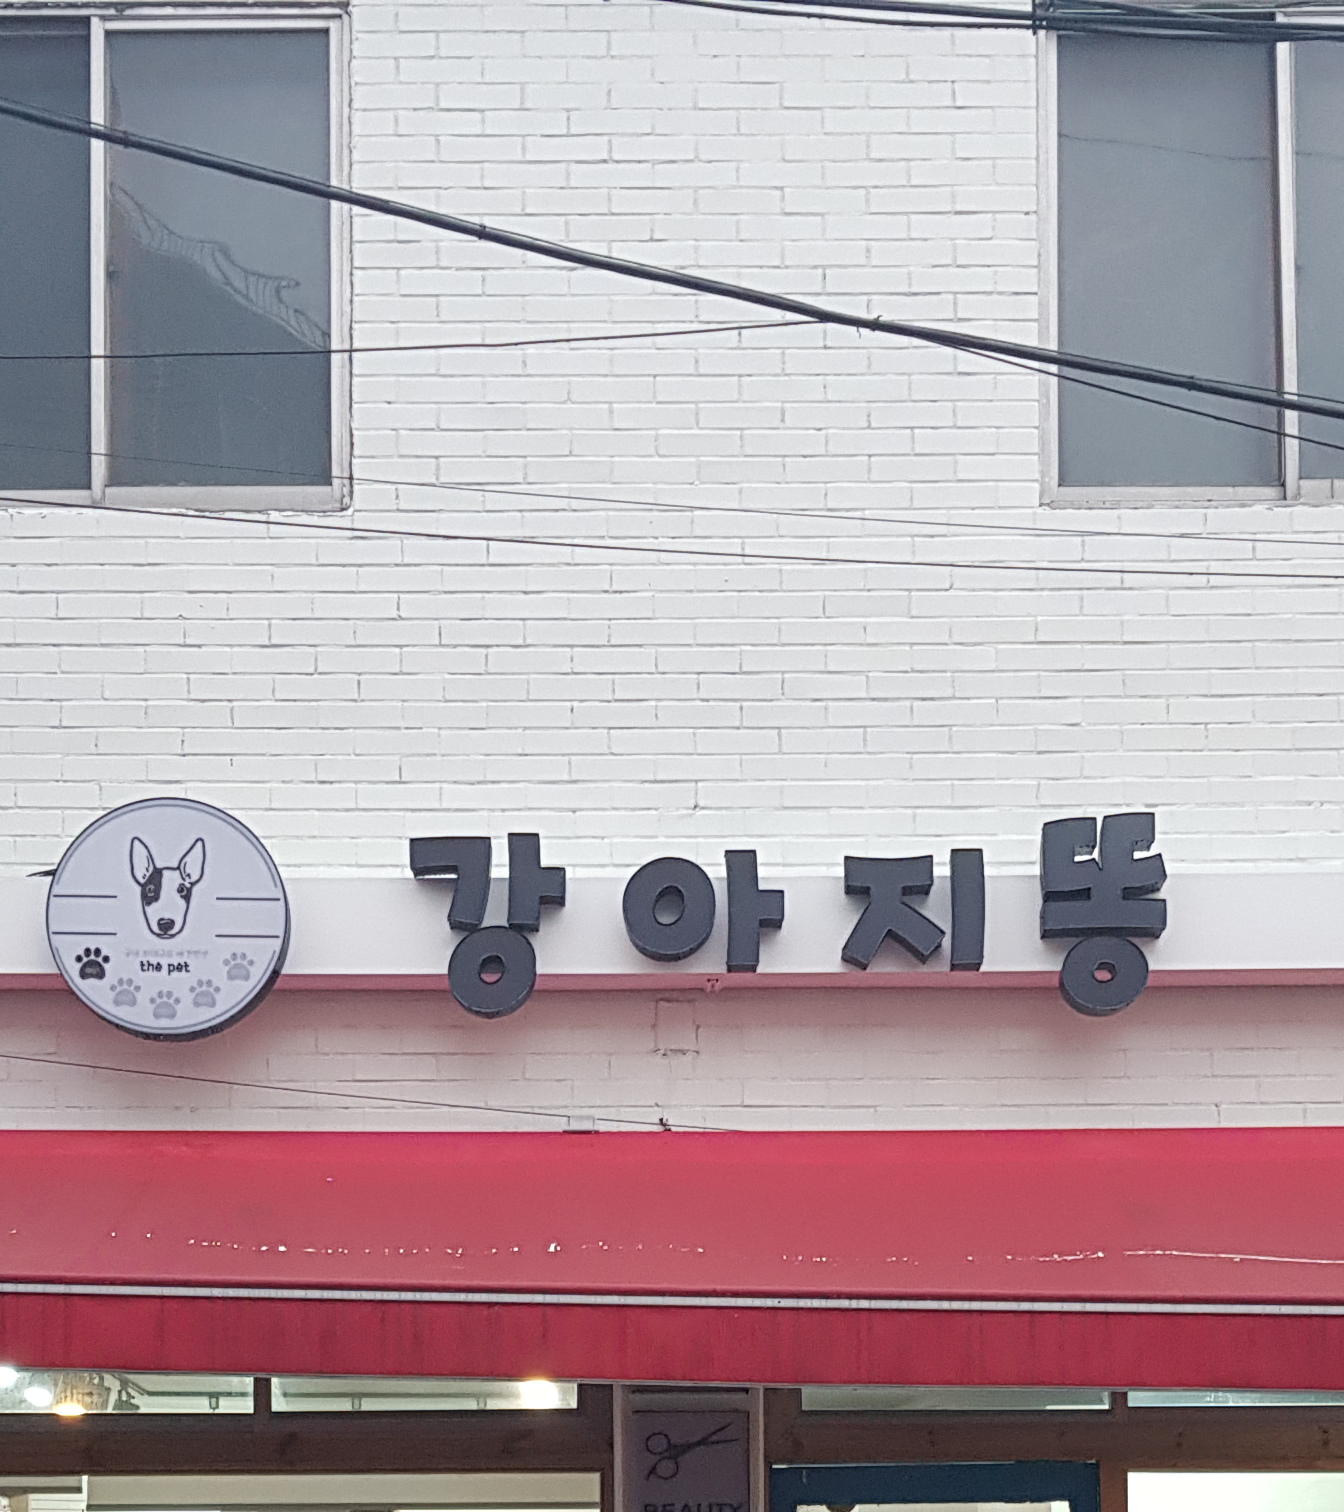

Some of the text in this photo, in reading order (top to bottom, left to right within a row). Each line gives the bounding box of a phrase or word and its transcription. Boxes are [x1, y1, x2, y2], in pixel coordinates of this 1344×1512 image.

[140, 960, 191, 976] the pet
[409, 812, 1168, 1019] 강아지똥
